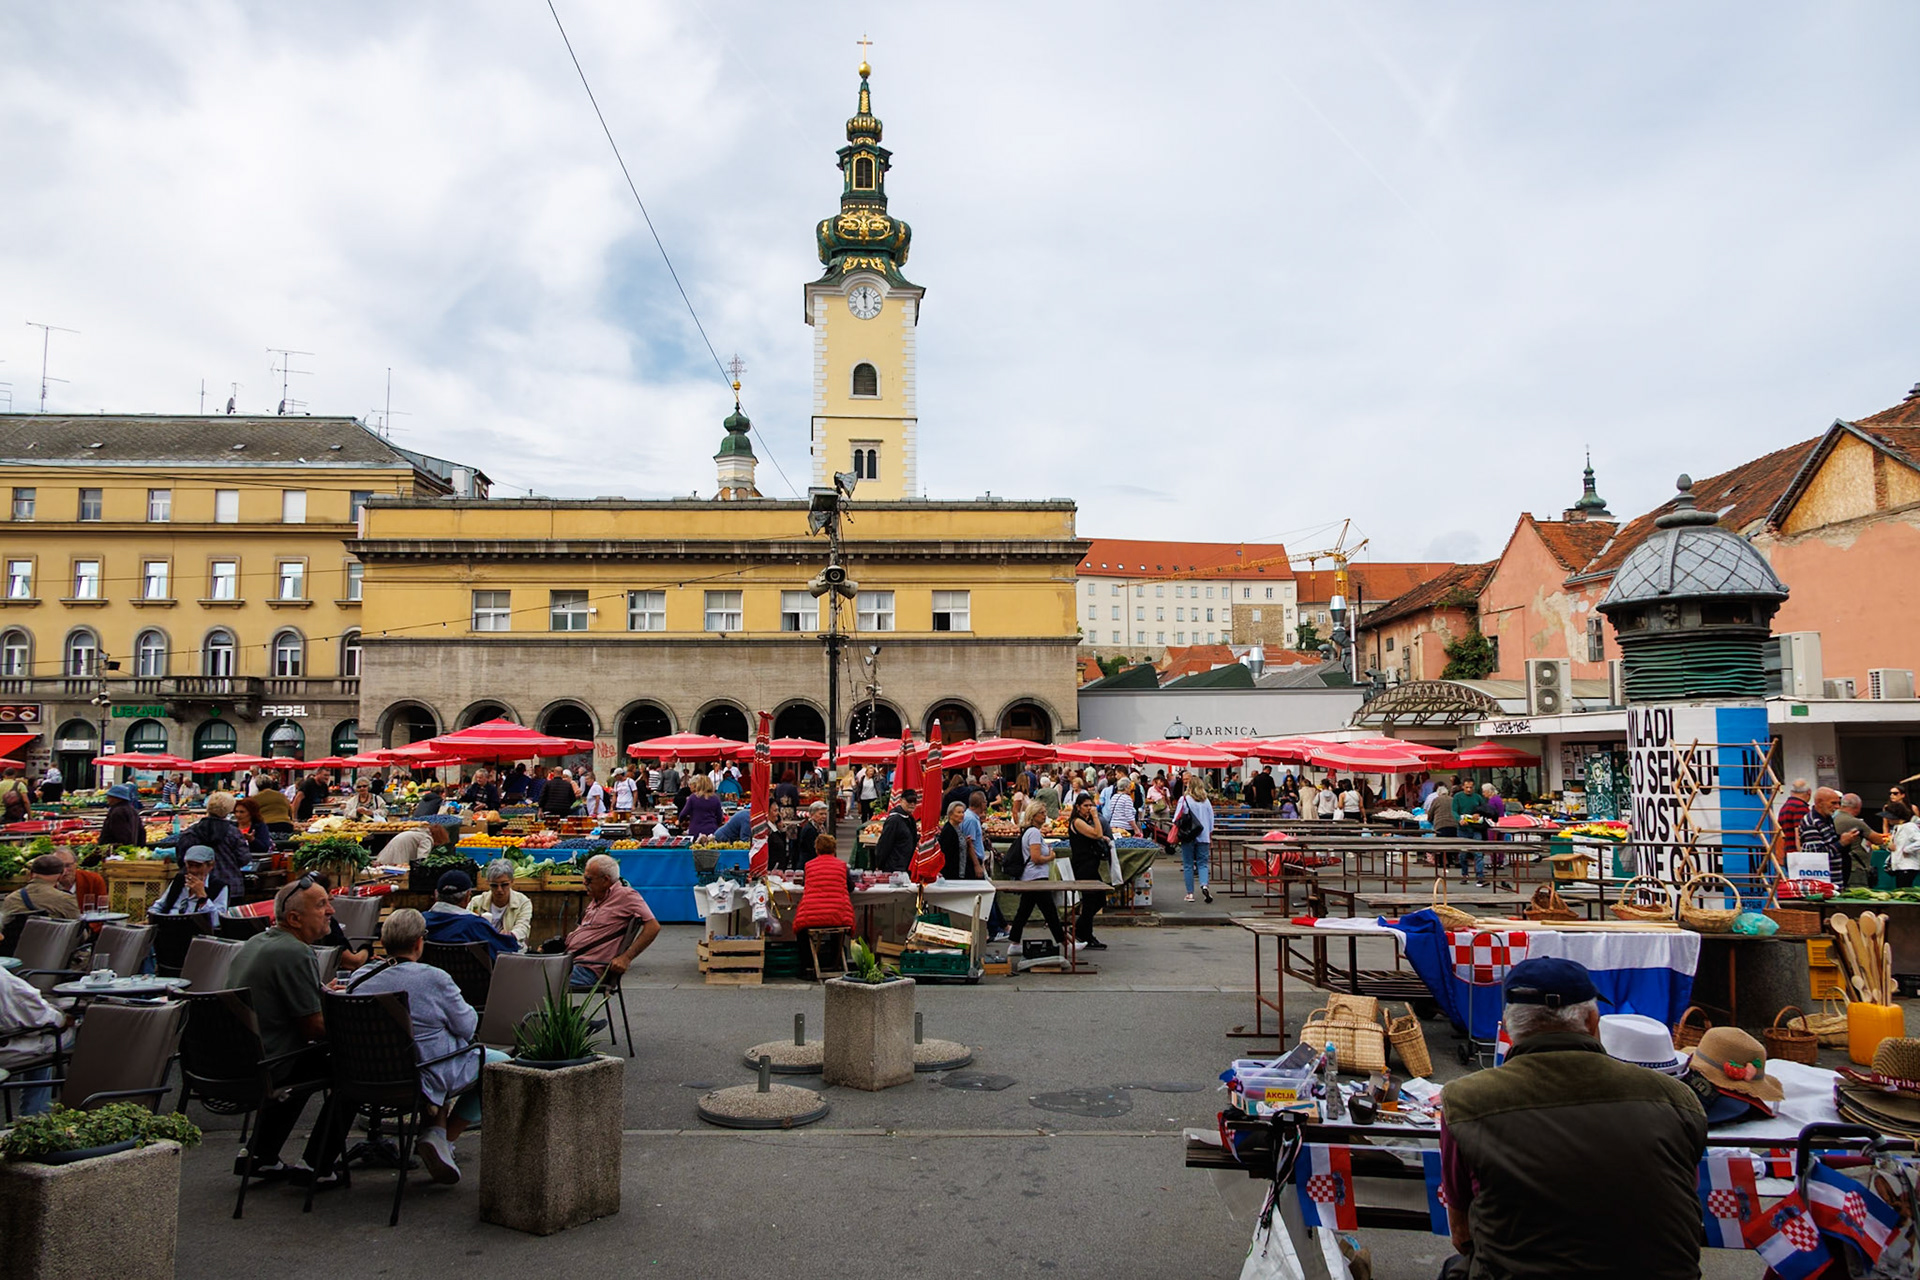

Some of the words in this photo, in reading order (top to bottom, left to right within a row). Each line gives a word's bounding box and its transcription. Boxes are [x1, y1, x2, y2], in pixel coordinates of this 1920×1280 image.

[1189, 726, 1258, 736] IBARNICA
[1628, 708, 1674, 748] MLADI
[1799, 869, 1830, 877] nama
[1266, 1091, 1295, 1099] AKCIJA
